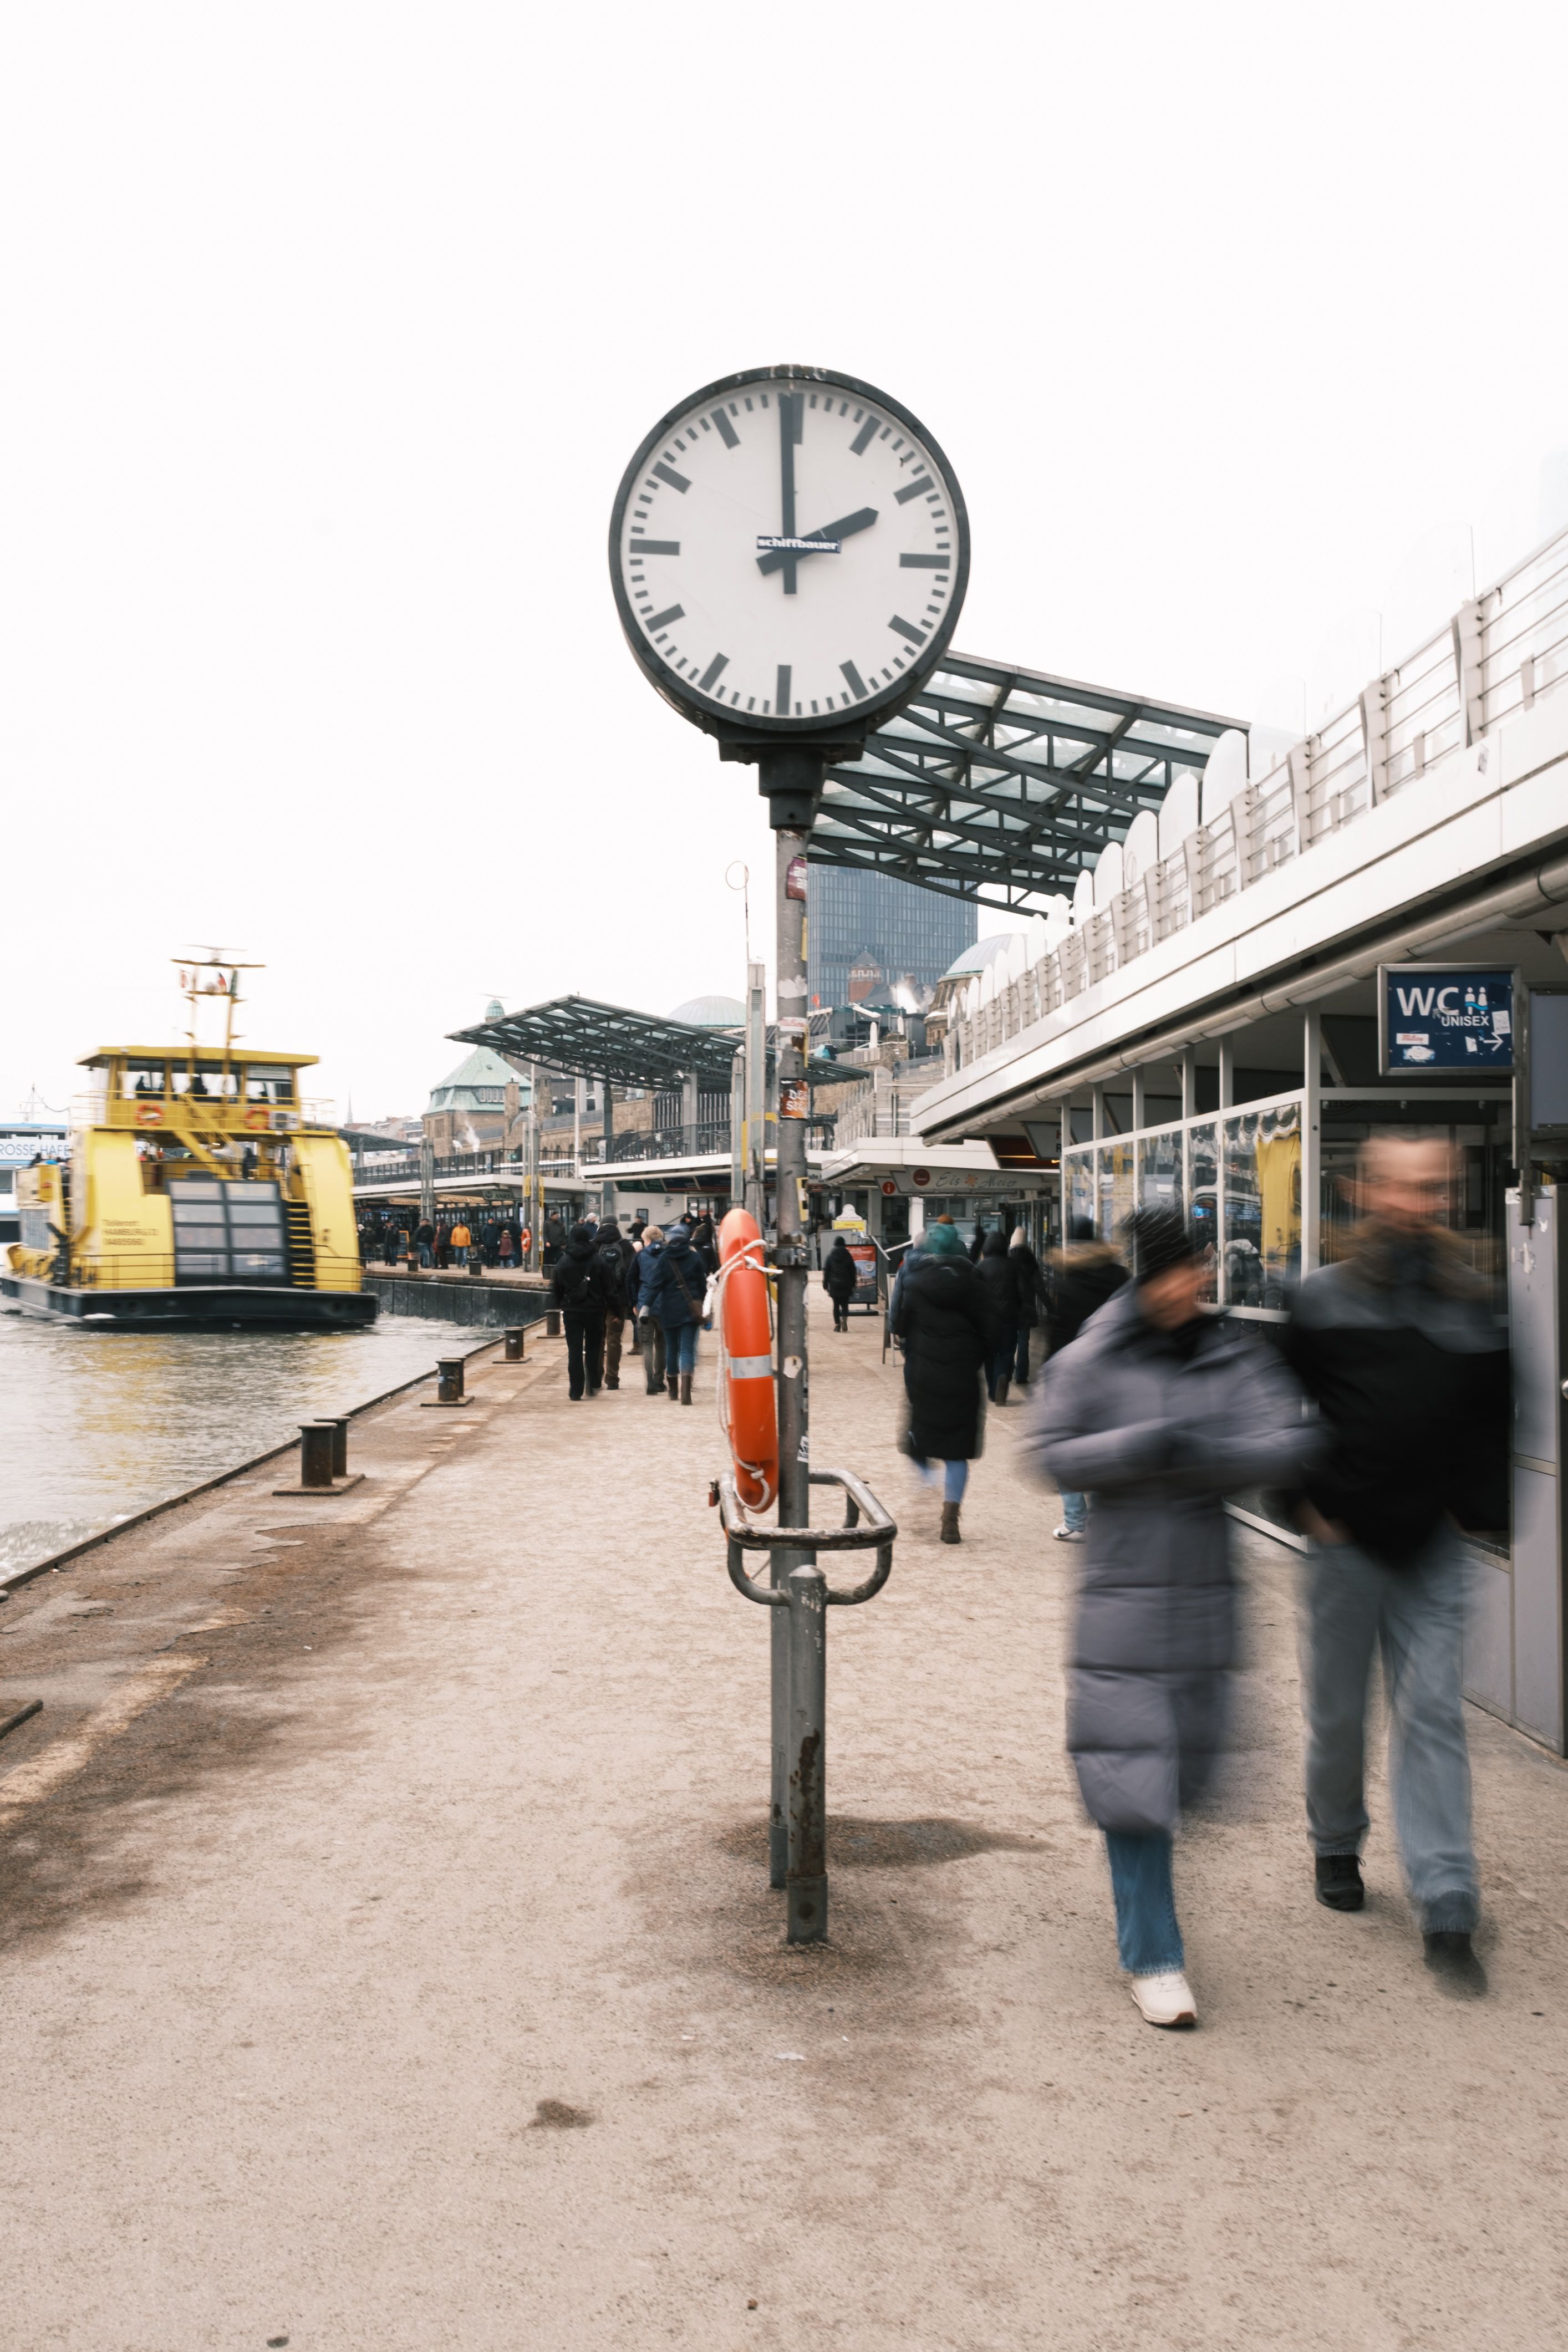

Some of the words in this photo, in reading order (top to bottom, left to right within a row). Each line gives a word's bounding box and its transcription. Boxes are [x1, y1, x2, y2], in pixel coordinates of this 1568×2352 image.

[757, 537, 838, 550] schiffbauer
[1396, 986, 1459, 1016] WC
[1441, 1015, 1490, 1027] UNISEX
[40, 1144, 74, 1157] HAFE
[936, 1172, 960, 1187] Eis
